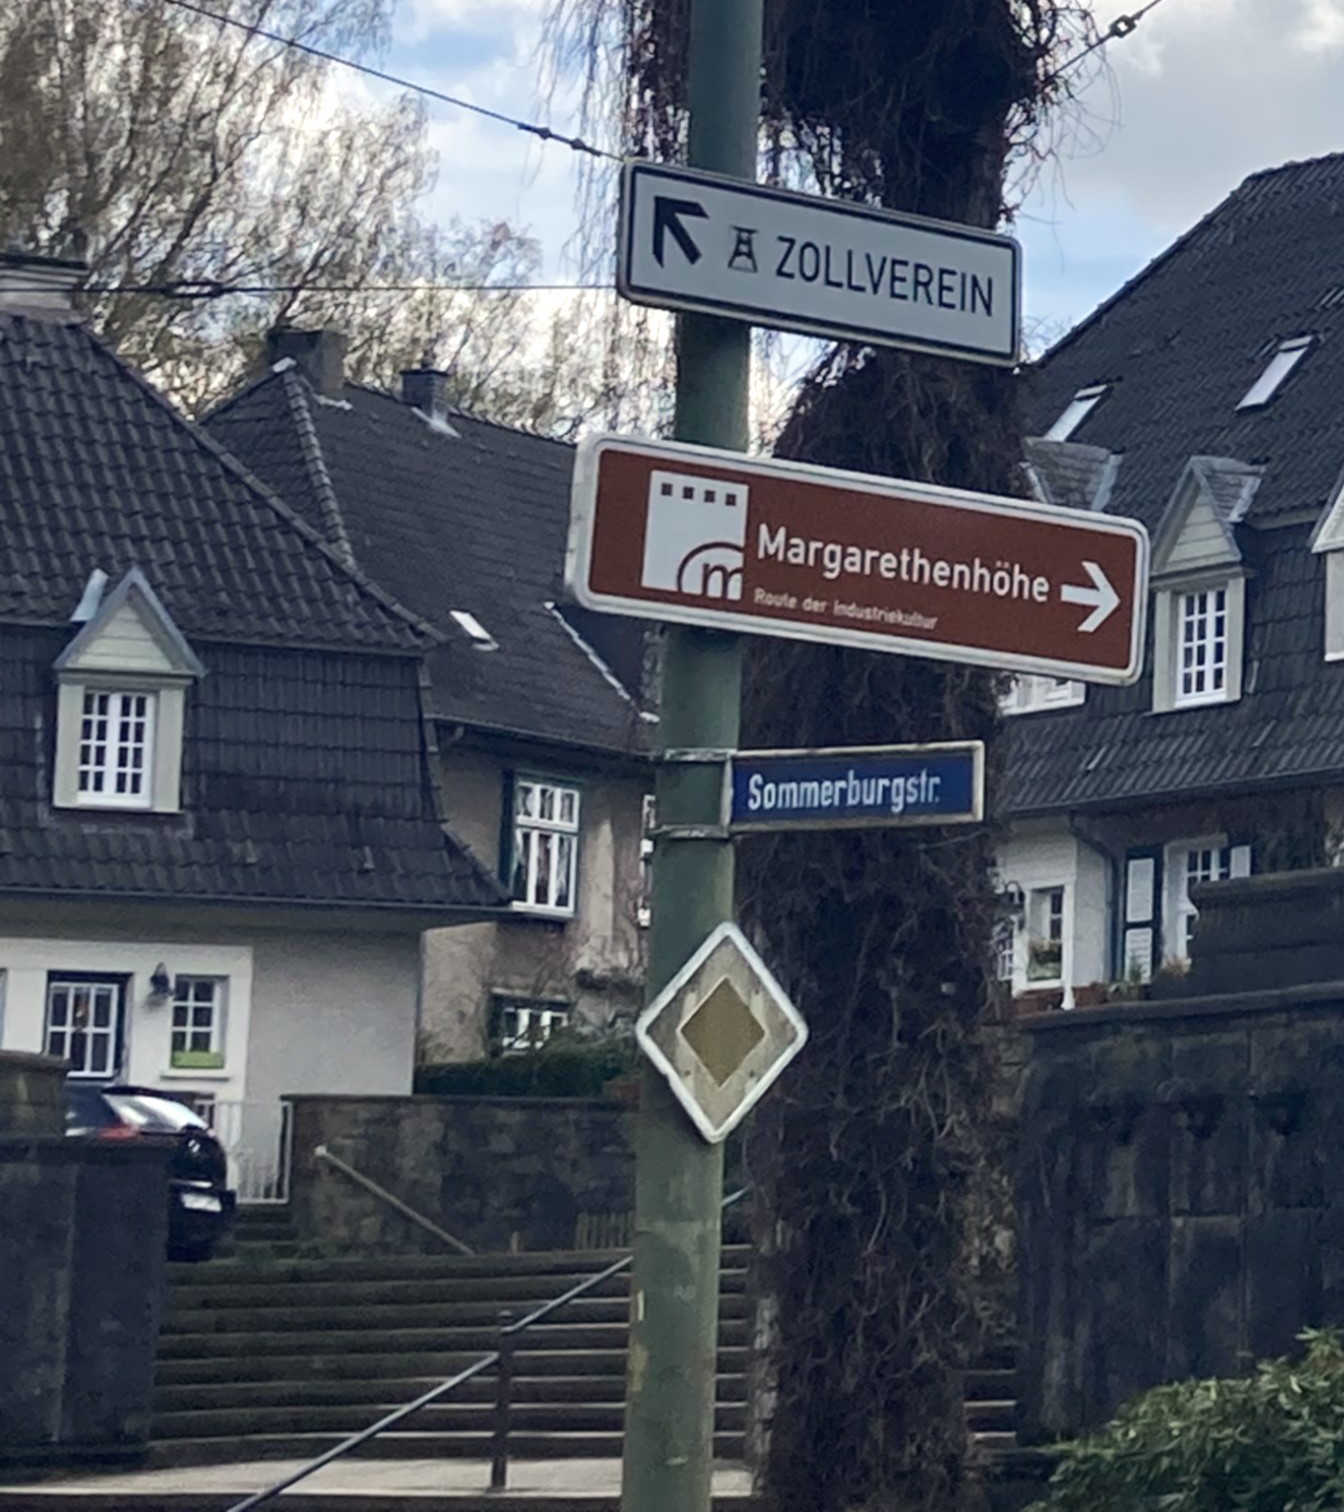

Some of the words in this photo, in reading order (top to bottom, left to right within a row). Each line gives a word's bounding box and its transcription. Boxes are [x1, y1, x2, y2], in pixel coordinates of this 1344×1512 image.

[776, 235, 993, 318] ZOLLVEREIN
[758, 523, 1051, 602] Margarethenhöhe
[754, 587, 797, 609] Route
[802, 596, 827, 612] der
[833, 599, 939, 630] Industriekultur
[748, 769, 941, 813] Sommerburgstr.
